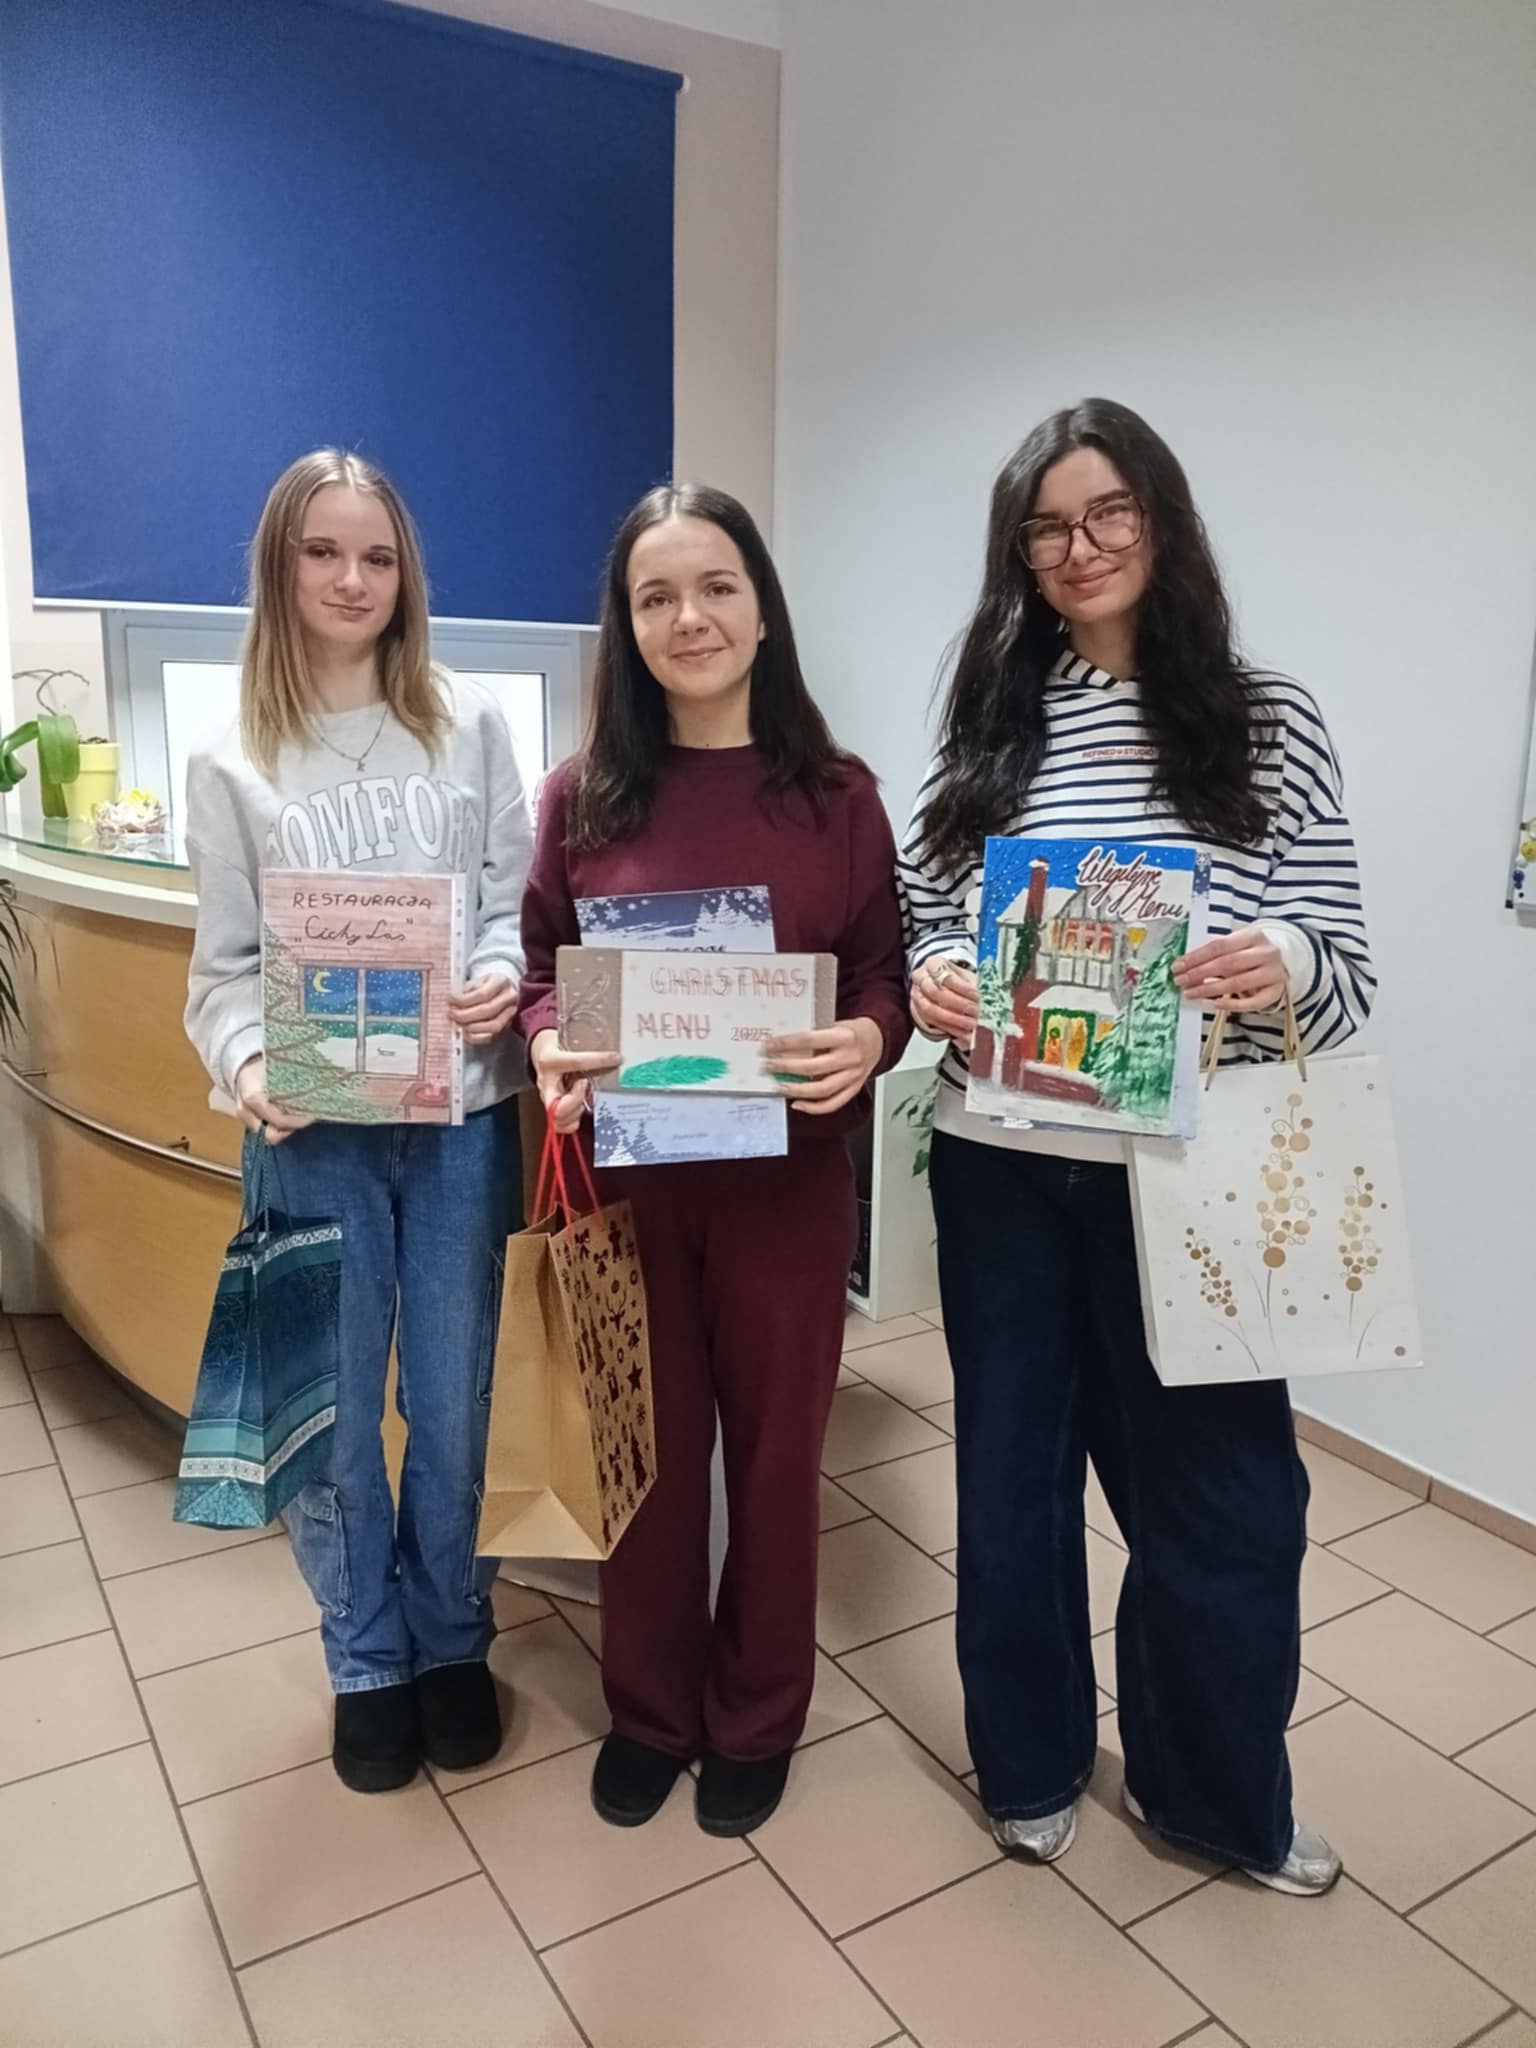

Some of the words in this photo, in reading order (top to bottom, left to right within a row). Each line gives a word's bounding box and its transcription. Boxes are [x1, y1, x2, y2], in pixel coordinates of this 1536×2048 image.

[292, 891, 431, 909] RESTAURACJA
[1121, 885, 1184, 919] Menu
[650, 965, 809, 999] CHRISTMAS
[633, 1012, 711, 1041] MENU
[730, 1026, 775, 1042] 2025
